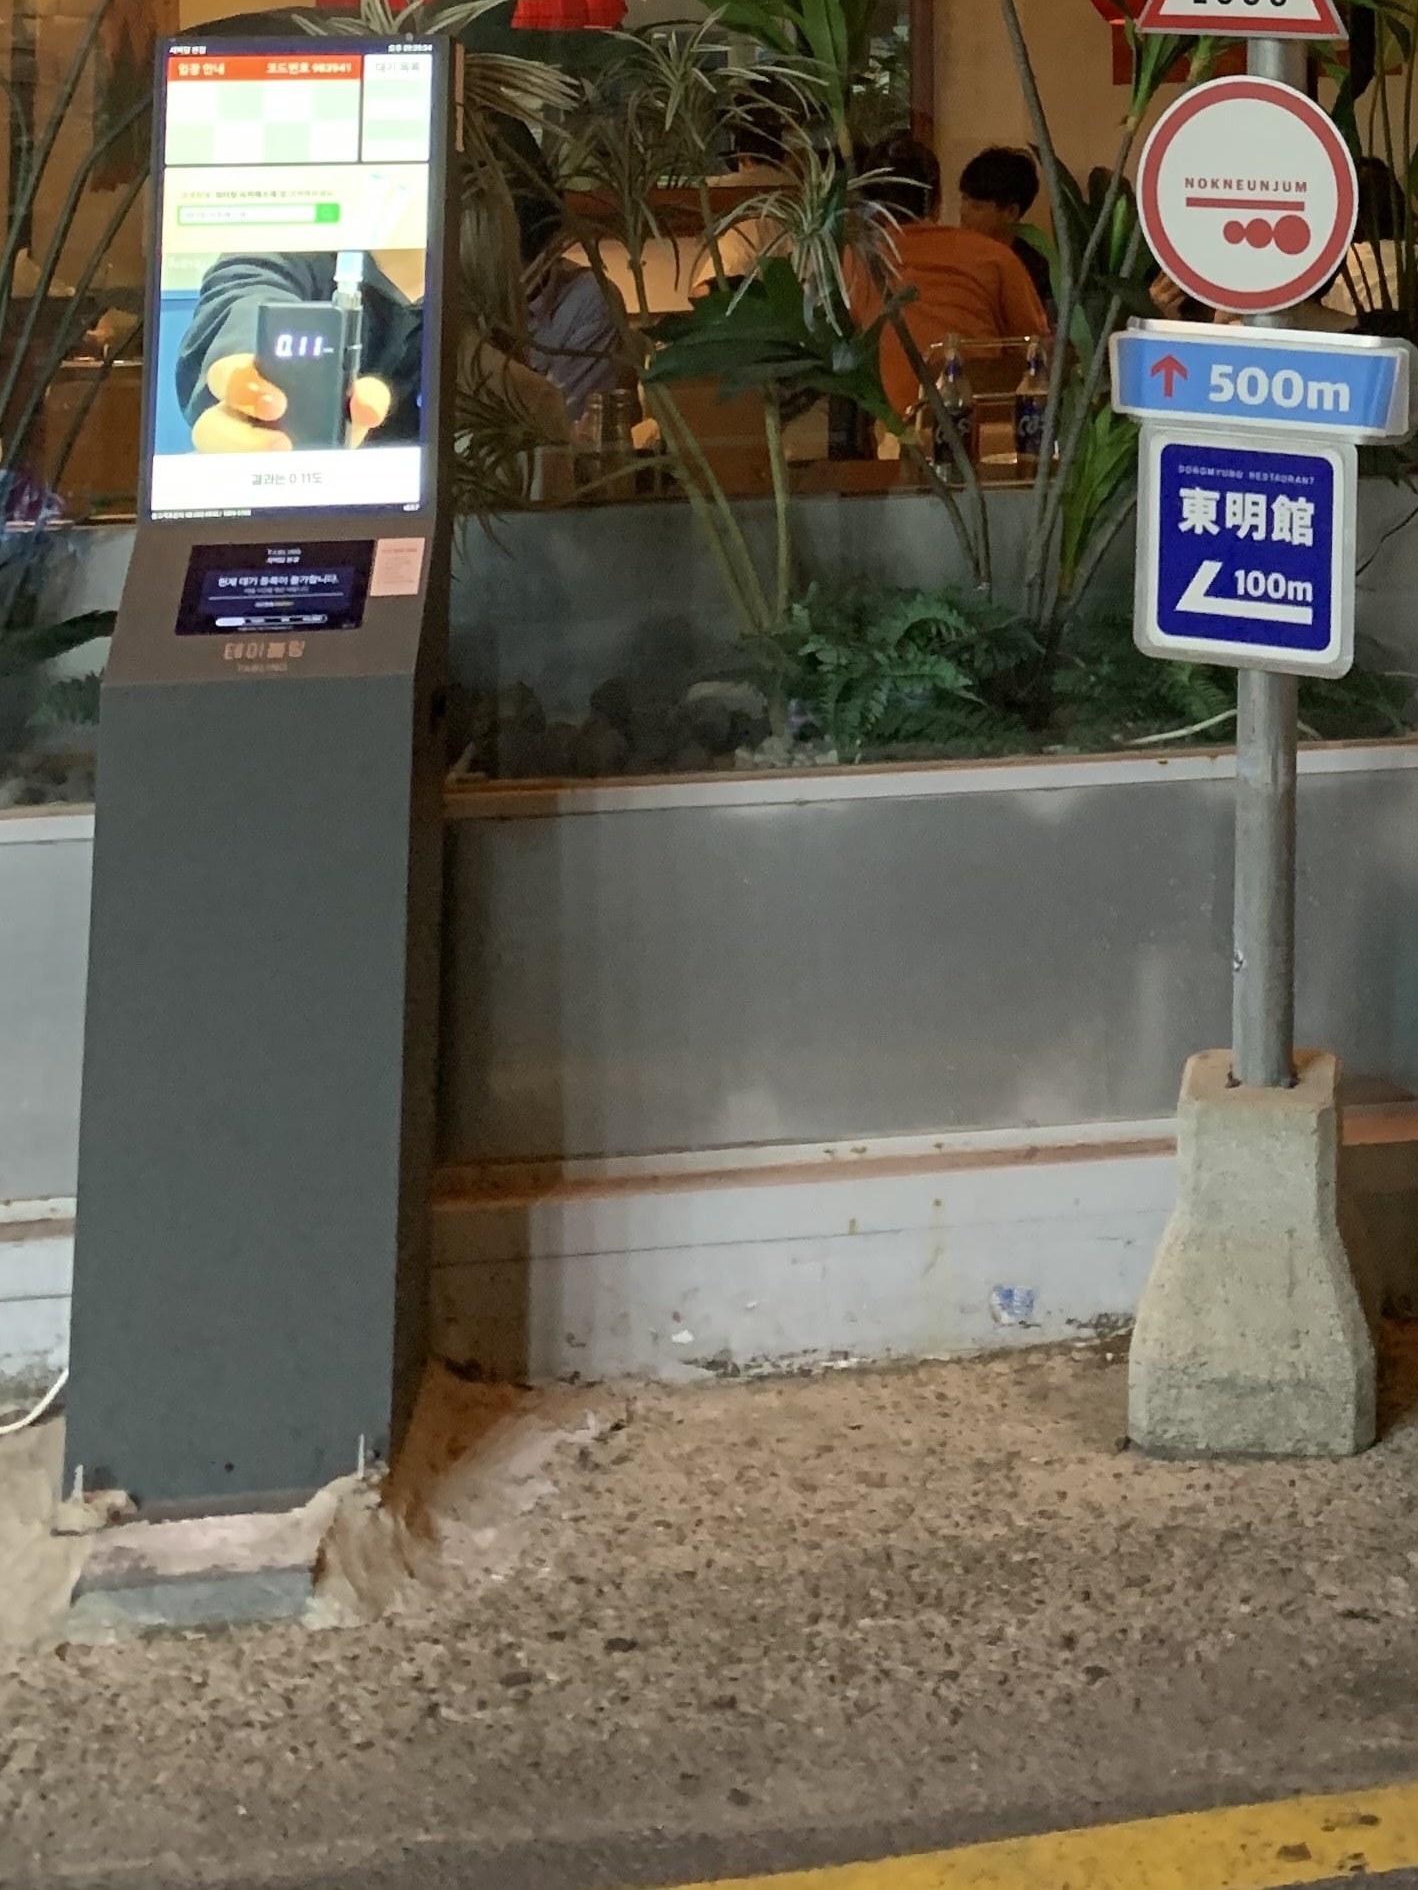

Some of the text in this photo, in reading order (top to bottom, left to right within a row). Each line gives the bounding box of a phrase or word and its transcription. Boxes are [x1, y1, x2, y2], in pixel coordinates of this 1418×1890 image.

[1184, 177, 1308, 193] NOKNEUNJUM
[1208, 364, 1350, 413] 500m
[251, 471, 322, 486] 결과는 011도
[1248, 471, 1315, 485] RESTAURANT
[1178, 485, 1315, 547] 東明館
[1234, 568, 1314, 603] 100m
